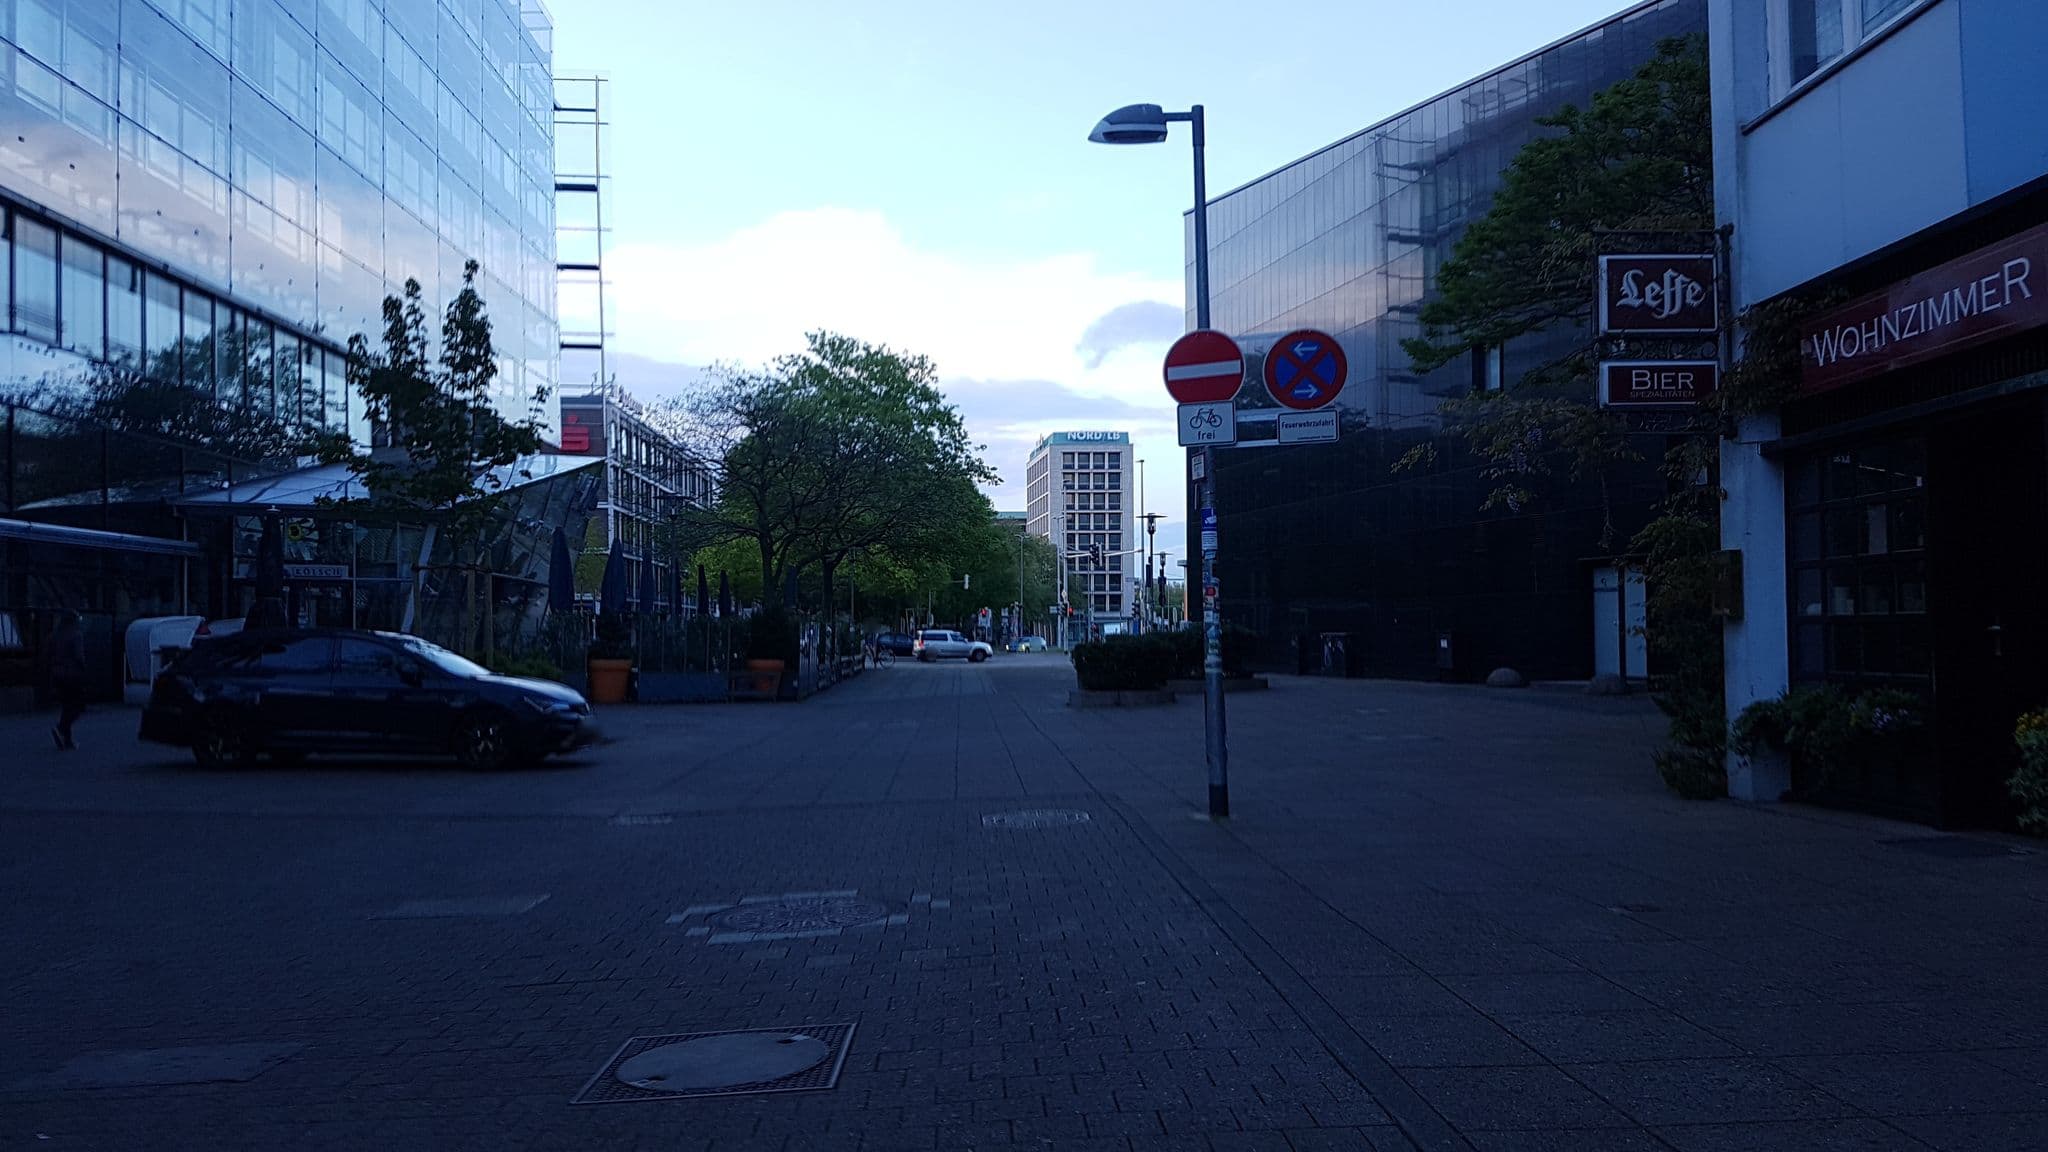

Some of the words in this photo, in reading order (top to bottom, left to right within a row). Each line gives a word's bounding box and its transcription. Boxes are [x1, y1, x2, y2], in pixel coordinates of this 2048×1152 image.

[1616, 268, 1706, 319] Leffe
[1813, 256, 2032, 367] WOHNZIMMER
[1632, 369, 1694, 390] BIER
[1281, 418, 1334, 429] Feuerwehrzufahrt
[1067, 431, 1121, 441] NORD/LB
[1198, 430, 1215, 441] frei
